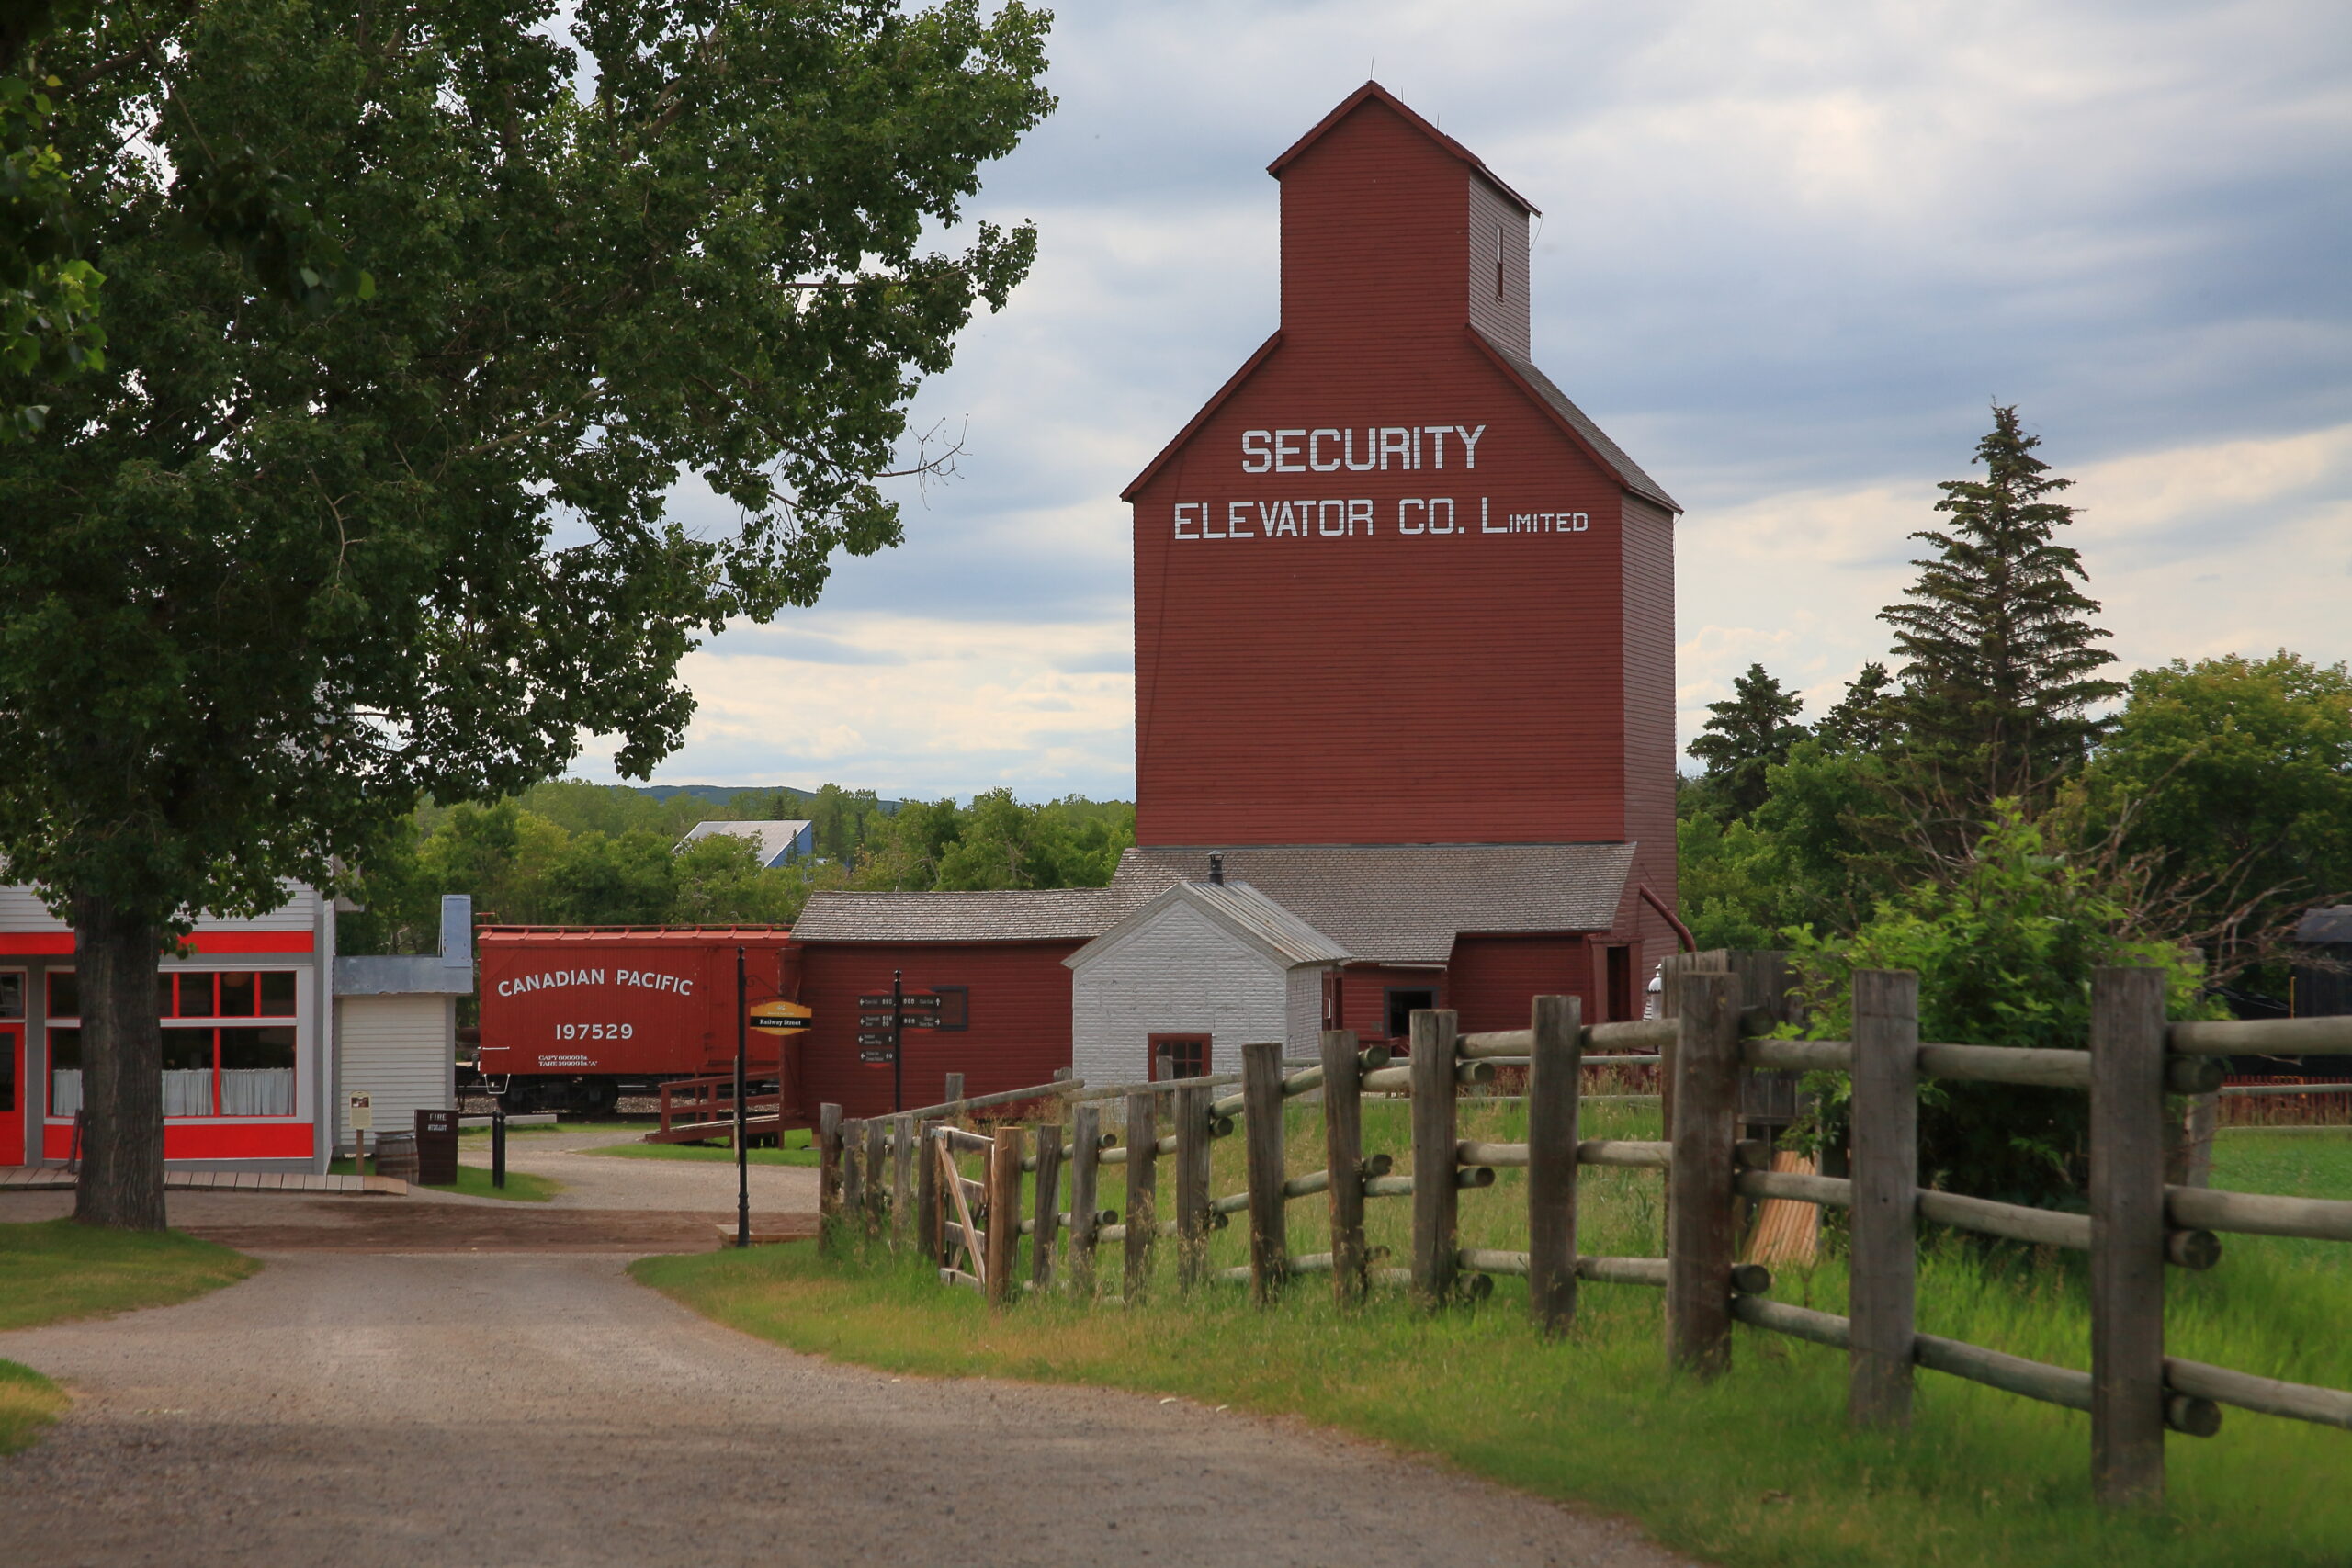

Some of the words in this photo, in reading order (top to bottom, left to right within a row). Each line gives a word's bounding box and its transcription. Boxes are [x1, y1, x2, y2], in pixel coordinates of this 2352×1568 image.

[1241, 423, 1487, 473] SECURITY
[1173, 499, 1374, 540] ELEVATOR
[1398, 497, 1465, 535] CO.
[1481, 496, 1589, 534] LIMITED
[497, 968, 605, 997] CANADIAN
[616, 969, 694, 996] PACIFIC
[555, 1023, 633, 1040] 197529
[760, 1019, 783, 1027] Railway
[429, 1113, 447, 1122] FIRE
